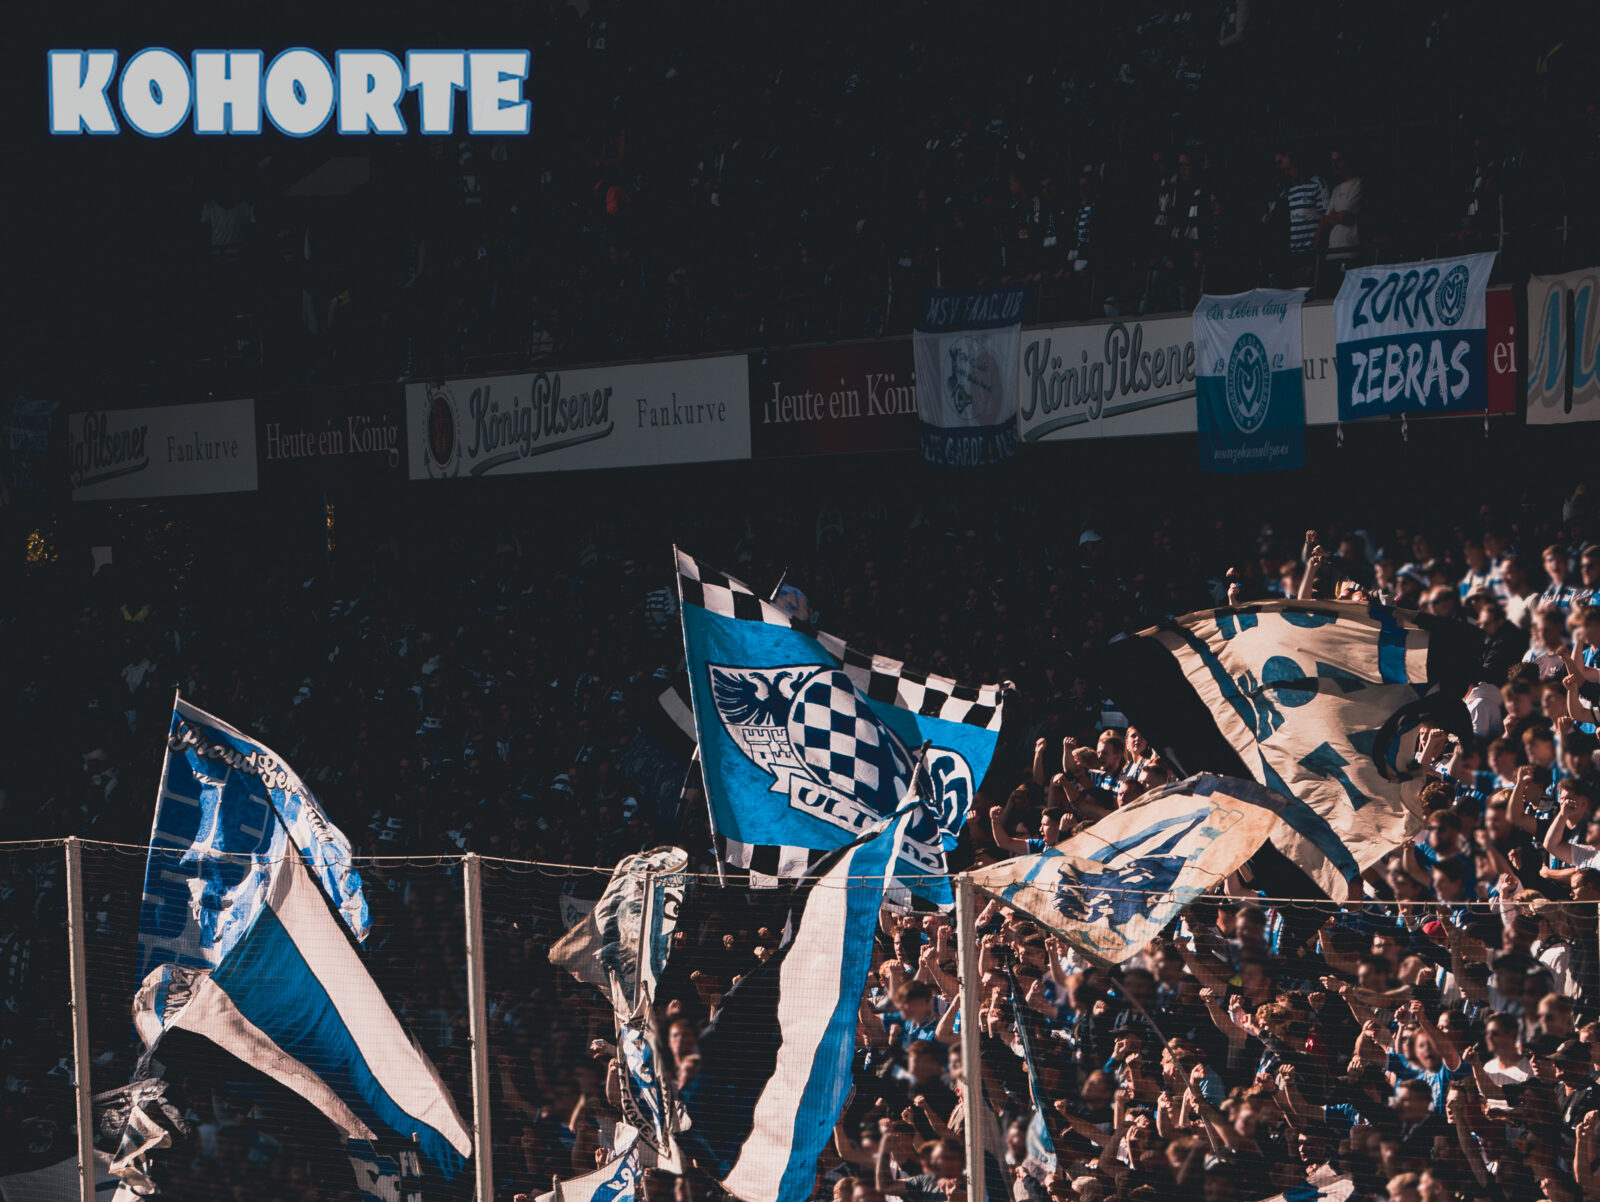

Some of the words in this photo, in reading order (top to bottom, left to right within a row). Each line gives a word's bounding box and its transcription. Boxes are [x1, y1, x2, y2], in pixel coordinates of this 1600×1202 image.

[1228, 300, 1259, 319] Leben
[1262, 299, 1288, 324] lang
[1022, 338, 1105, 421] König
[1103, 323, 1197, 399] Pilsene
[1351, 338, 1471, 407] ZEBRAS
[1493, 326, 1517, 374] ei
[468, 385, 531, 457] König
[531, 373, 613, 440] Pilsener
[636, 393, 727, 428] Fankurve
[762, 382, 825, 423] Heute
[829, 378, 861, 419] ein
[865, 373, 918, 417] Köni
[166, 430, 239, 464] Fankurve
[265, 423, 315, 460] Heute
[318, 418, 344, 456] ein
[348, 414, 400, 468] König
